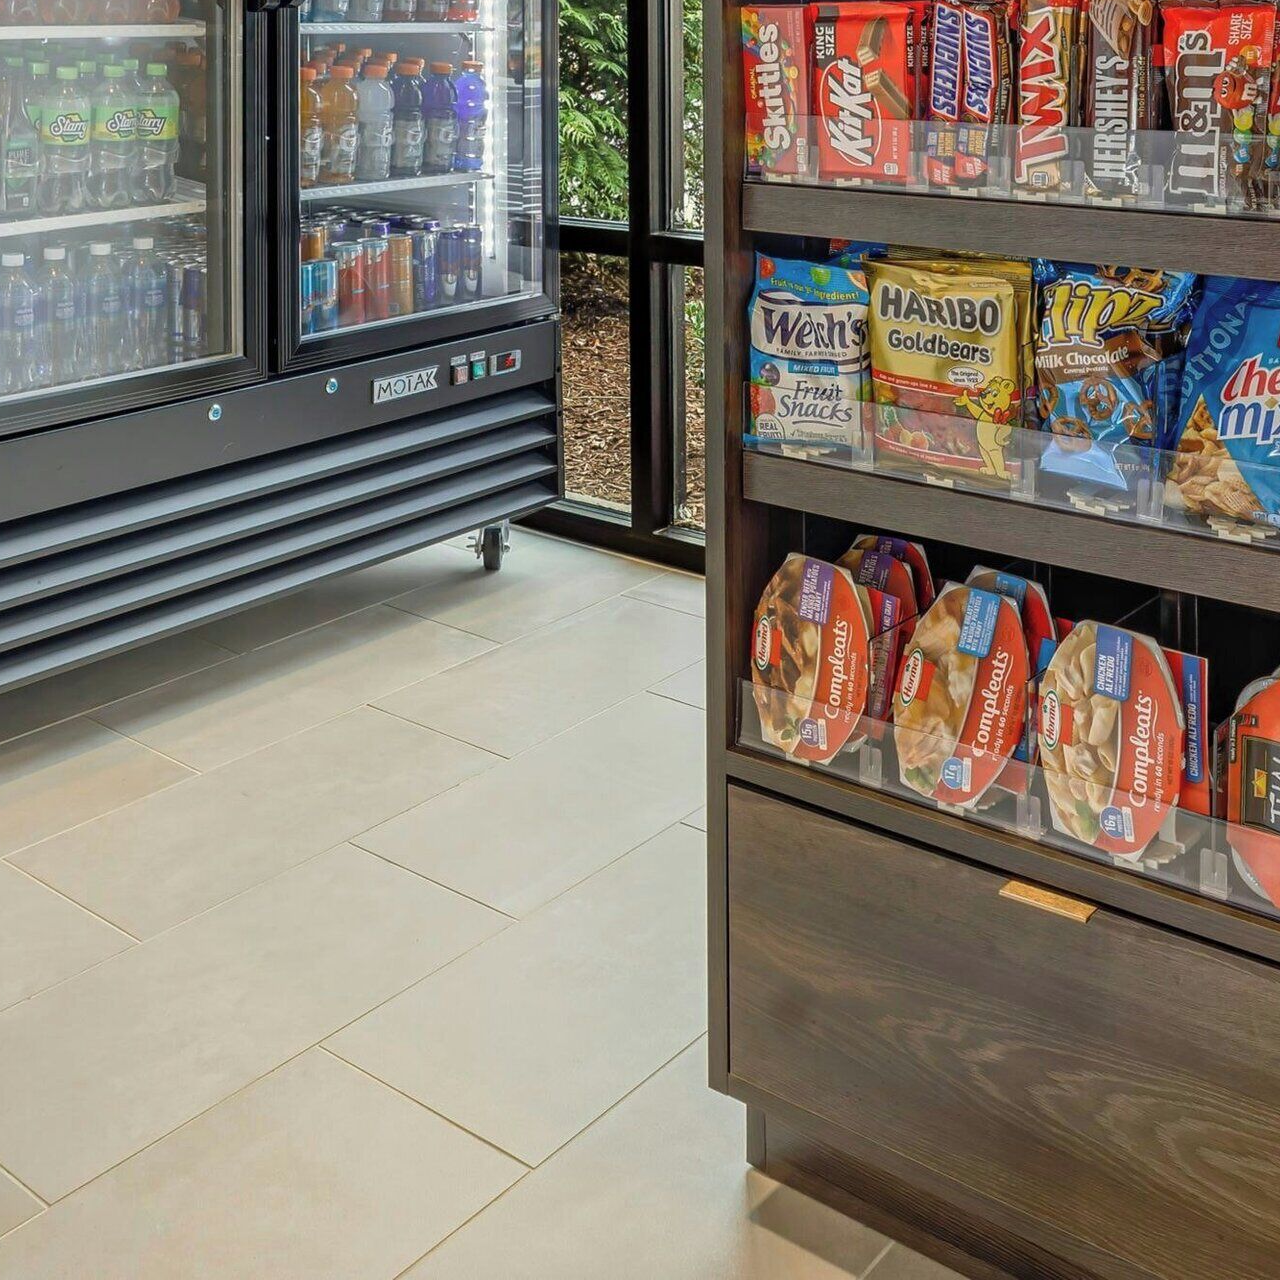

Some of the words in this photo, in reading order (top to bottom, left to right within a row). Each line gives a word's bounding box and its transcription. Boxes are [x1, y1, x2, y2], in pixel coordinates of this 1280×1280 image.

[815, 25, 824, 59] KING
[825, 25, 835, 57] SIZE
[1228, 12, 1241, 45] SHARE
[1240, 14, 1253, 40] SIZE
[932, 4, 961, 118] SNICKERS
[758, 23, 791, 151] Skittles
[1015, 14, 1069, 184] TWIX
[1093, 55, 1129, 177] HERSHEY'S
[880, 282, 1002, 336] HARIBO
[888, 329, 992, 364] Goldbears
[1035, 354, 1064, 368] Milk
[1066, 346, 1129, 366] Chocolate
[377, 371, 434, 399] MOTAK
[793, 364, 819, 373] MIXED
[778, 394, 853, 422] Snacks
[793, 381, 843, 401] Fruit
[759, 422, 778, 430] REAL
[757, 619, 769, 666] Hormel
[825, 621, 848, 719] Compleats
[902, 652, 922, 705] Hormel
[1096, 654, 1106, 691] CHICKEN
[1106, 655, 1116, 695] ALFREDO
[972, 651, 1009, 757] Compleats
[1045, 694, 1057, 746] Hormel
[1188, 703, 1197, 743] ALFREDO
[1129, 695, 1155, 808] Compleats
[1189, 745, 1198, 777] CHICKEN
